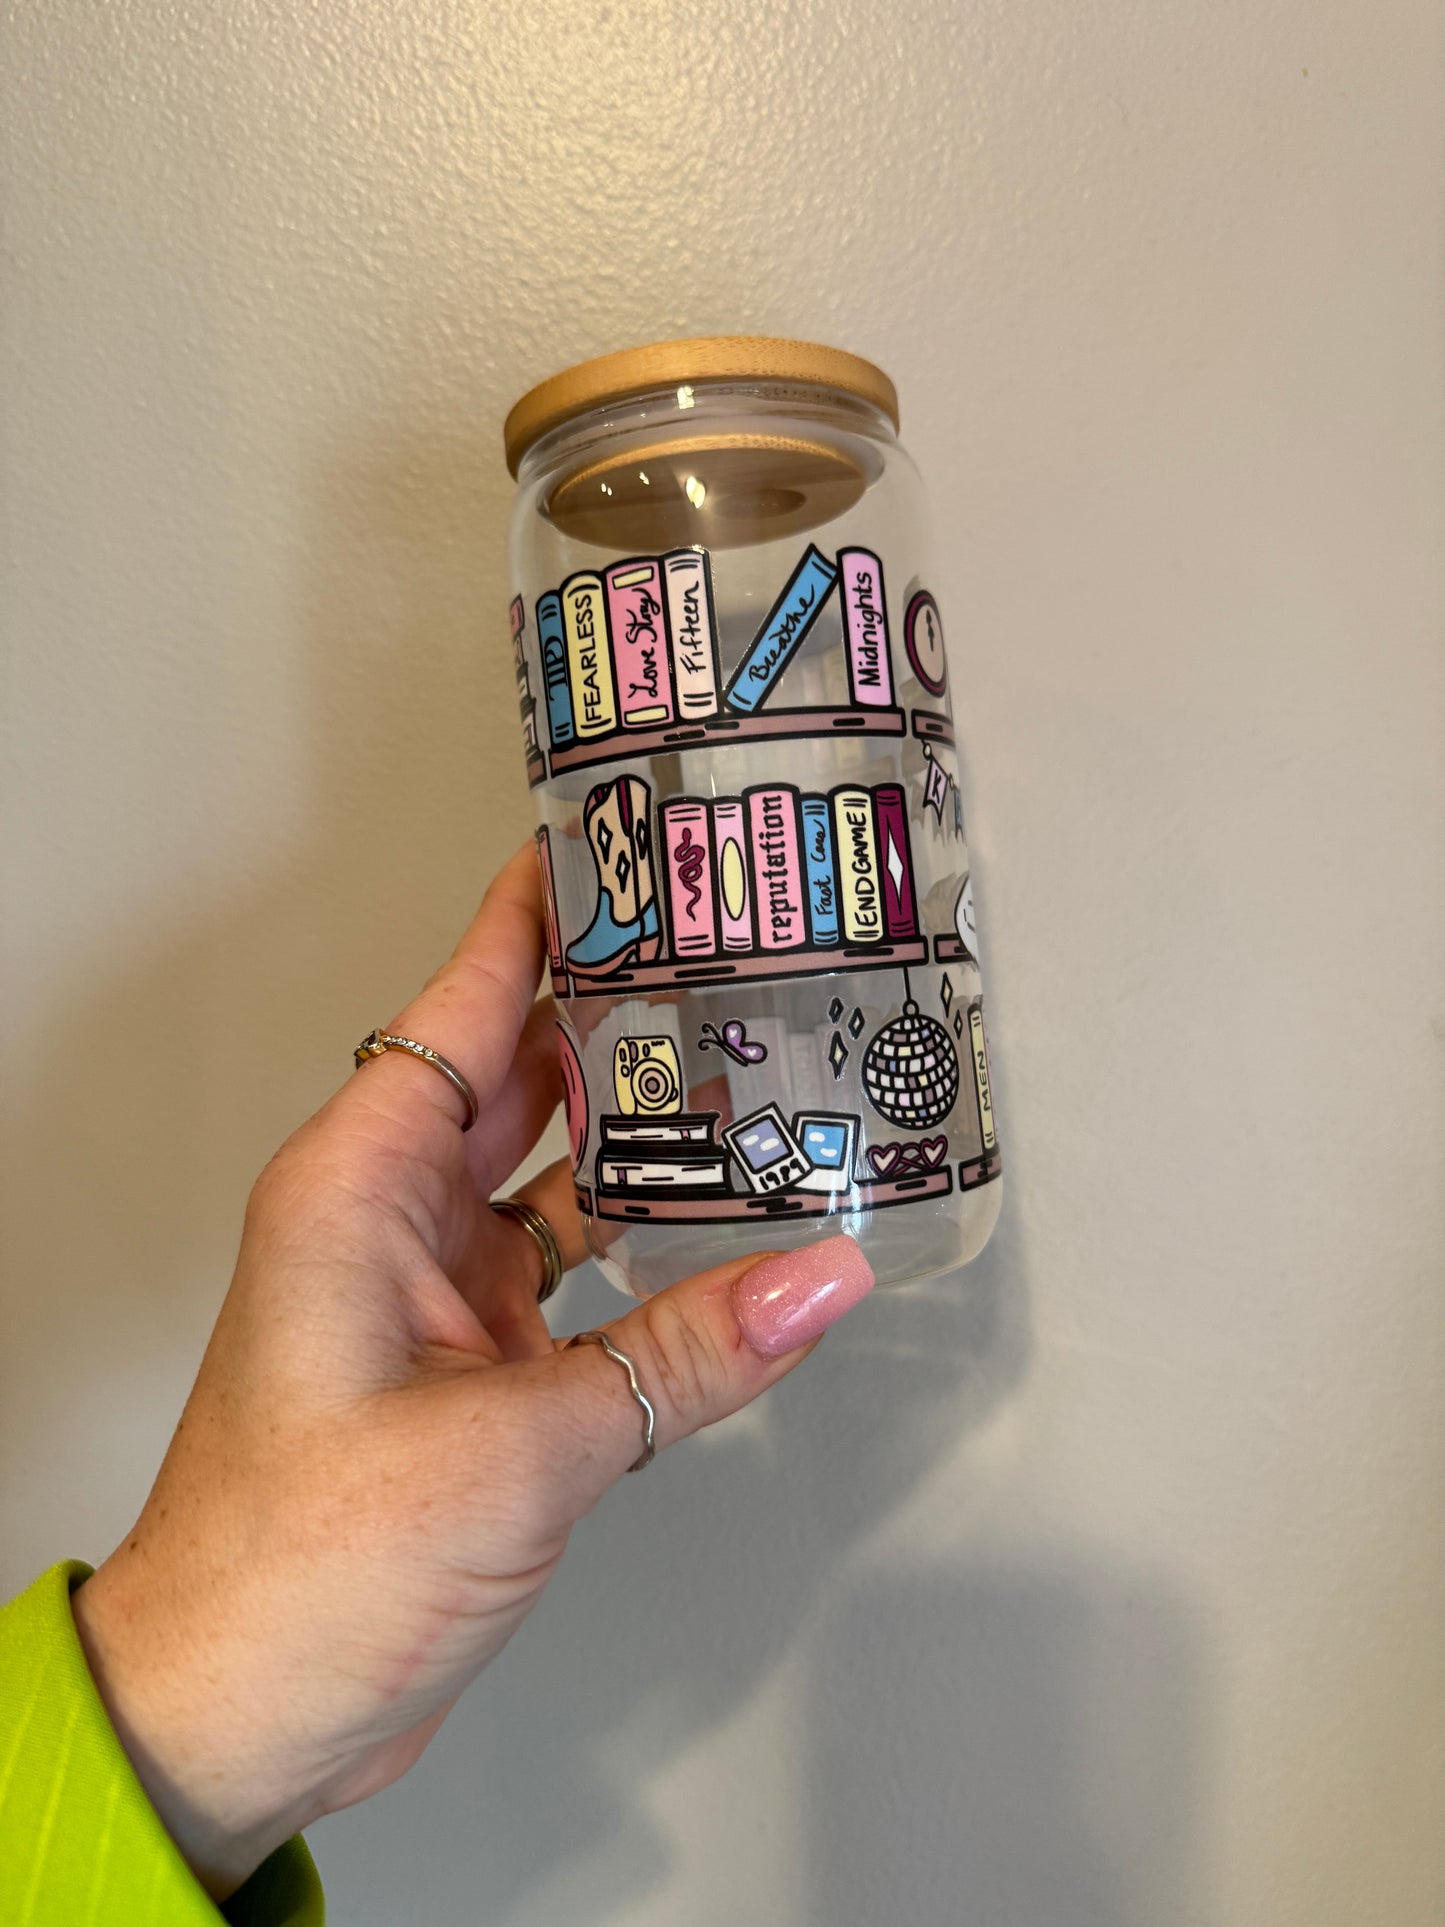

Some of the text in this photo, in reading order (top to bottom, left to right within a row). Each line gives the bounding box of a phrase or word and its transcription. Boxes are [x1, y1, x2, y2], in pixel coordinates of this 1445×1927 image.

[575, 594, 602, 722] FEARLESS
[626, 587, 661, 698] Love Story
[679, 580, 706, 676] Fifteen
[749, 584, 815, 683] Breathe
[852, 571, 883, 687] Midnights
[758, 795, 798, 943] reputation
[813, 875, 834, 916] Fast
[977, 1050, 991, 1113] MEN
[759, 1157, 806, 1191] 1989
